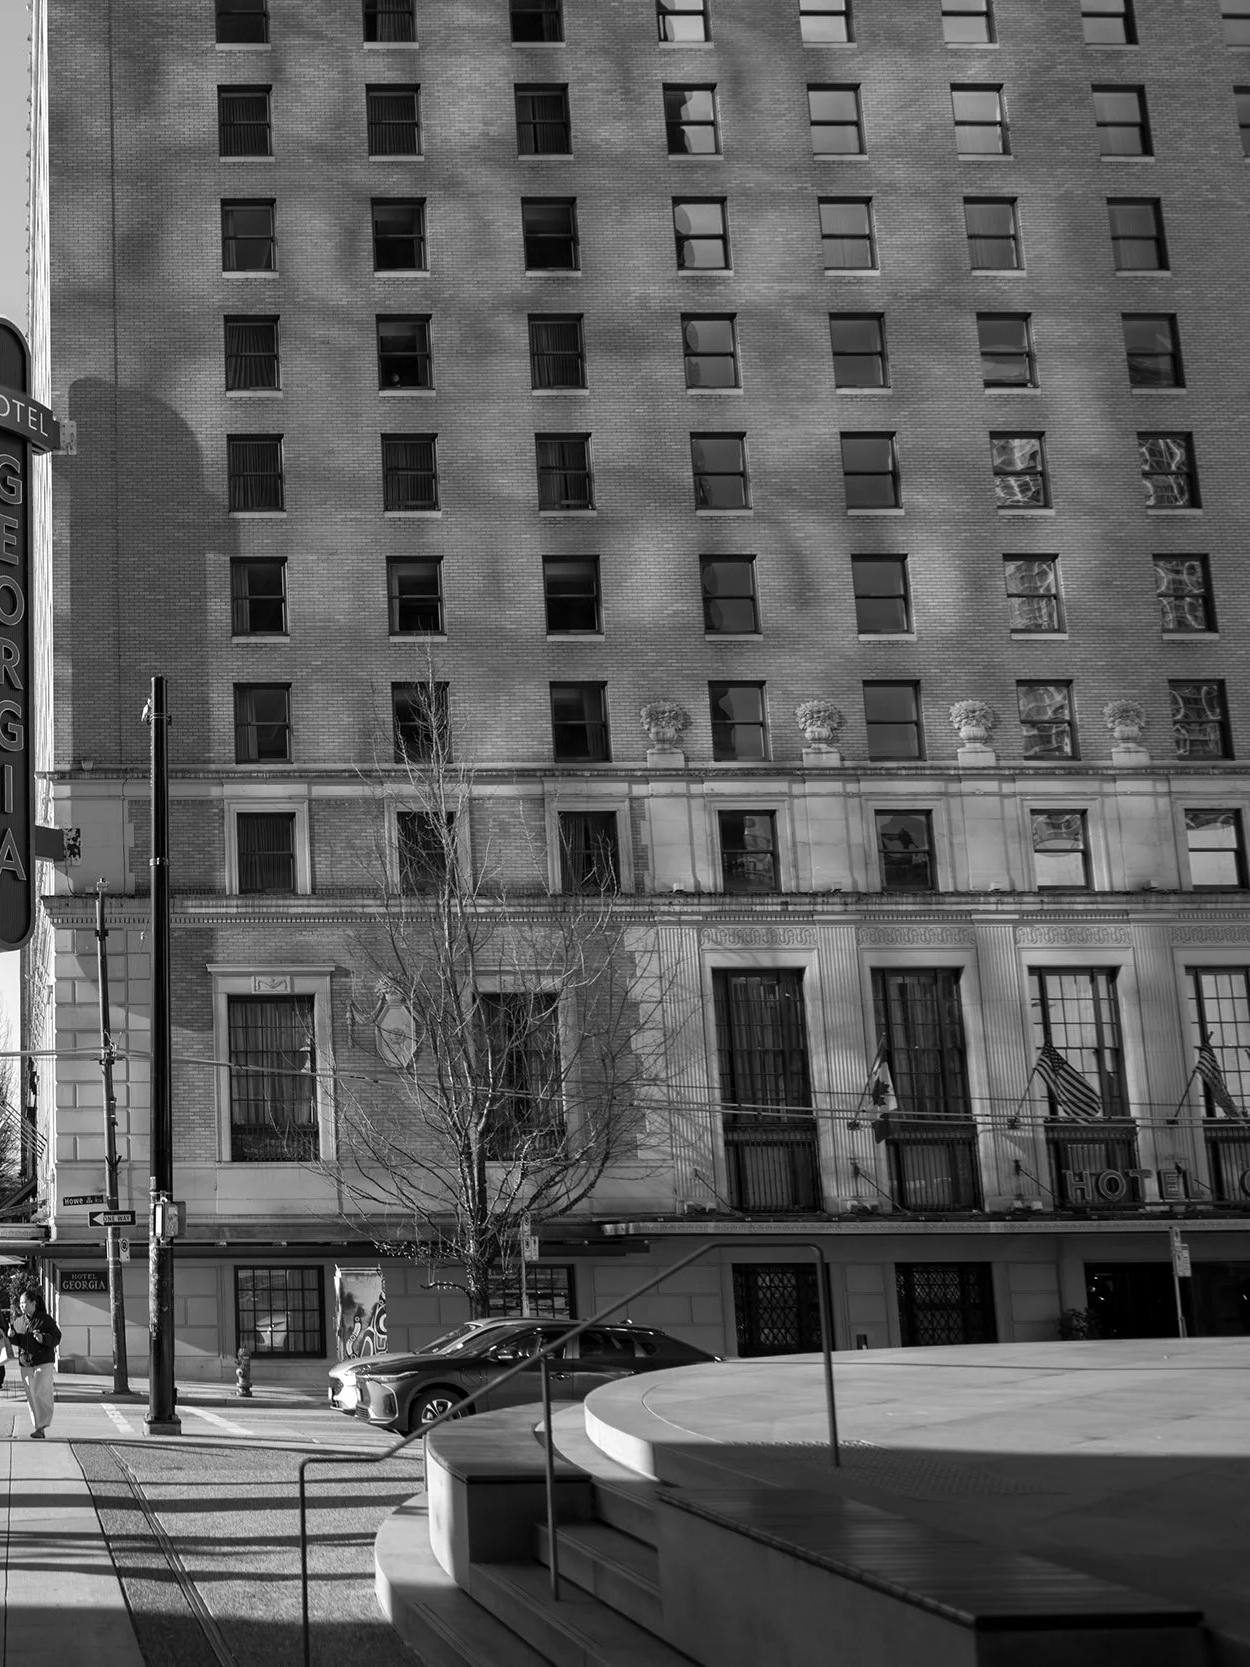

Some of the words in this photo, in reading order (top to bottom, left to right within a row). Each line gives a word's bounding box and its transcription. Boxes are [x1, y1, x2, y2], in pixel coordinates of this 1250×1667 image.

[1062, 1168, 1206, 1200] HOTEL
[64, 1197, 83, 1205] Howe
[117, 1214, 130, 1222] WAY
[62, 1280, 106, 1290] GEORGIA
